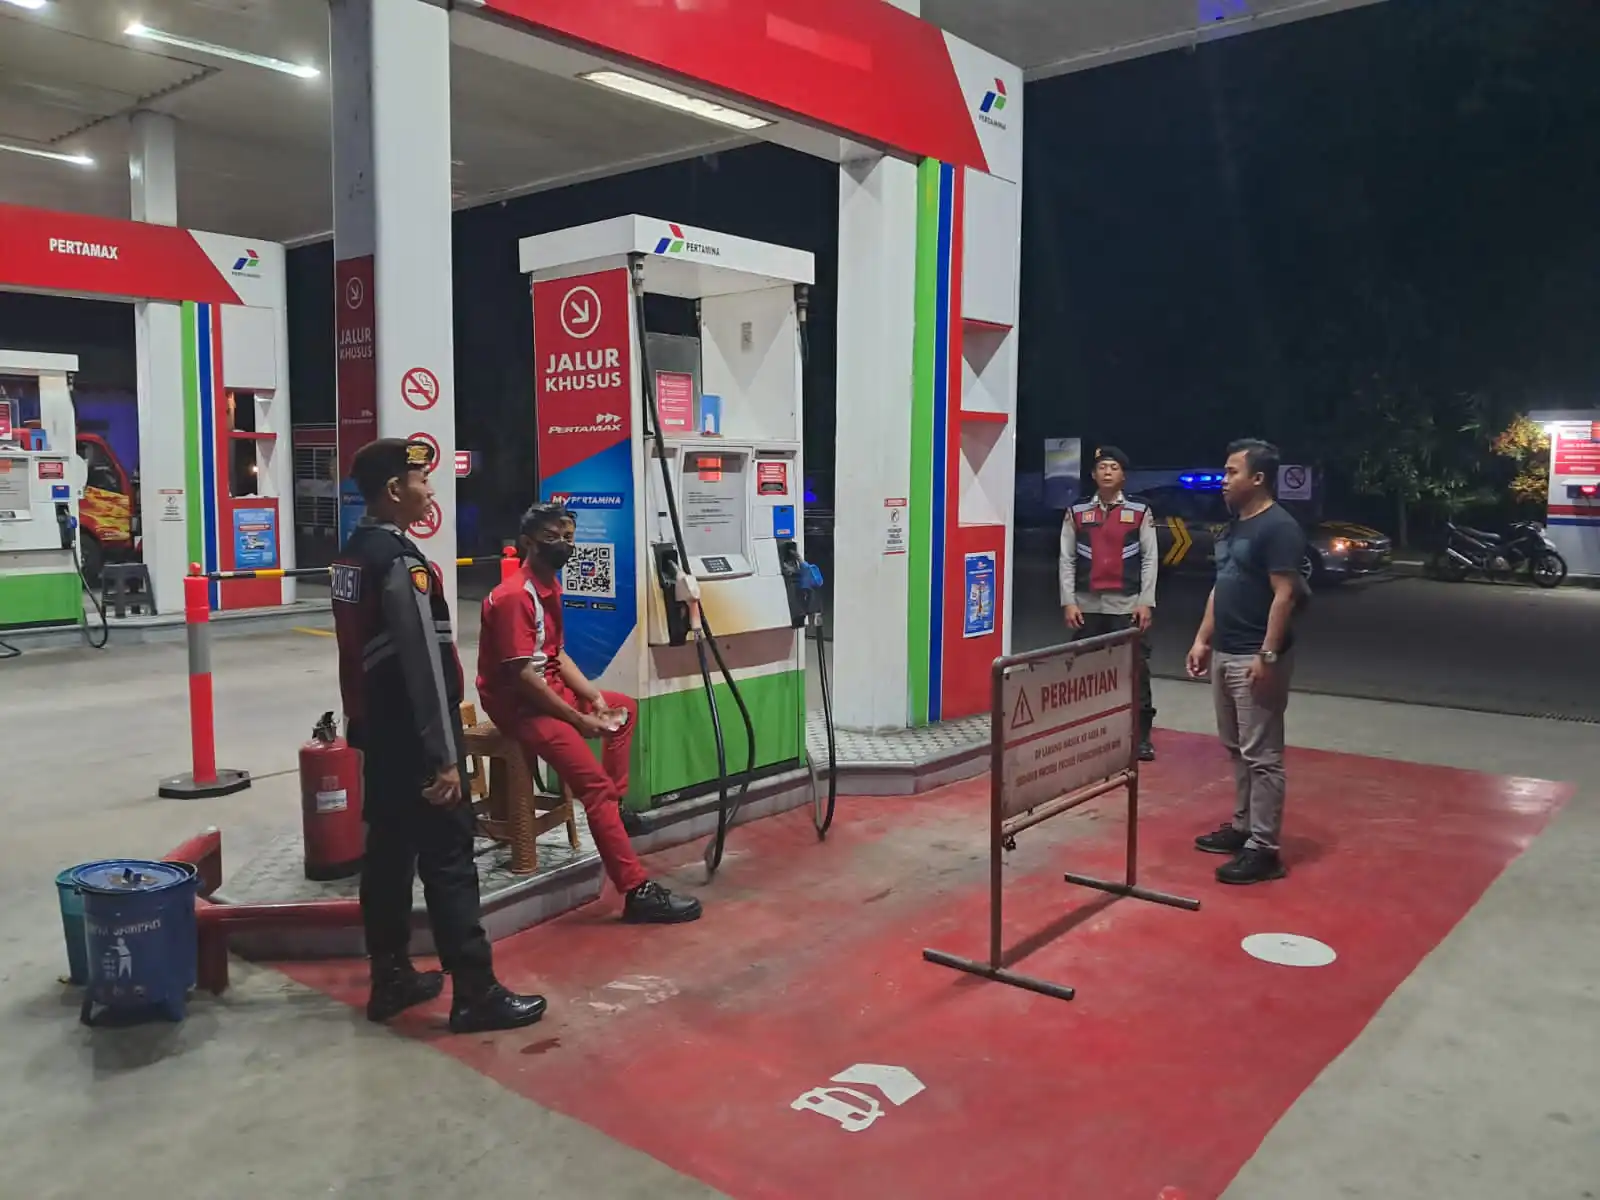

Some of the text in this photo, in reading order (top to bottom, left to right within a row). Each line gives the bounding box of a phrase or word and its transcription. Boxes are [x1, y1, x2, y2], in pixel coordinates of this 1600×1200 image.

[49, 238, 118, 260] PERTAMAX
[686, 242, 720, 256] PERTAMINA
[340, 327, 372, 345] JALUR
[340, 345, 373, 360] KHUSUS
[546, 348, 620, 374] JALUR
[545, 371, 621, 392] KHUSUS
[548, 424, 622, 434] PERTAMAX
[1041, 667, 1118, 712] PERHATIAN
